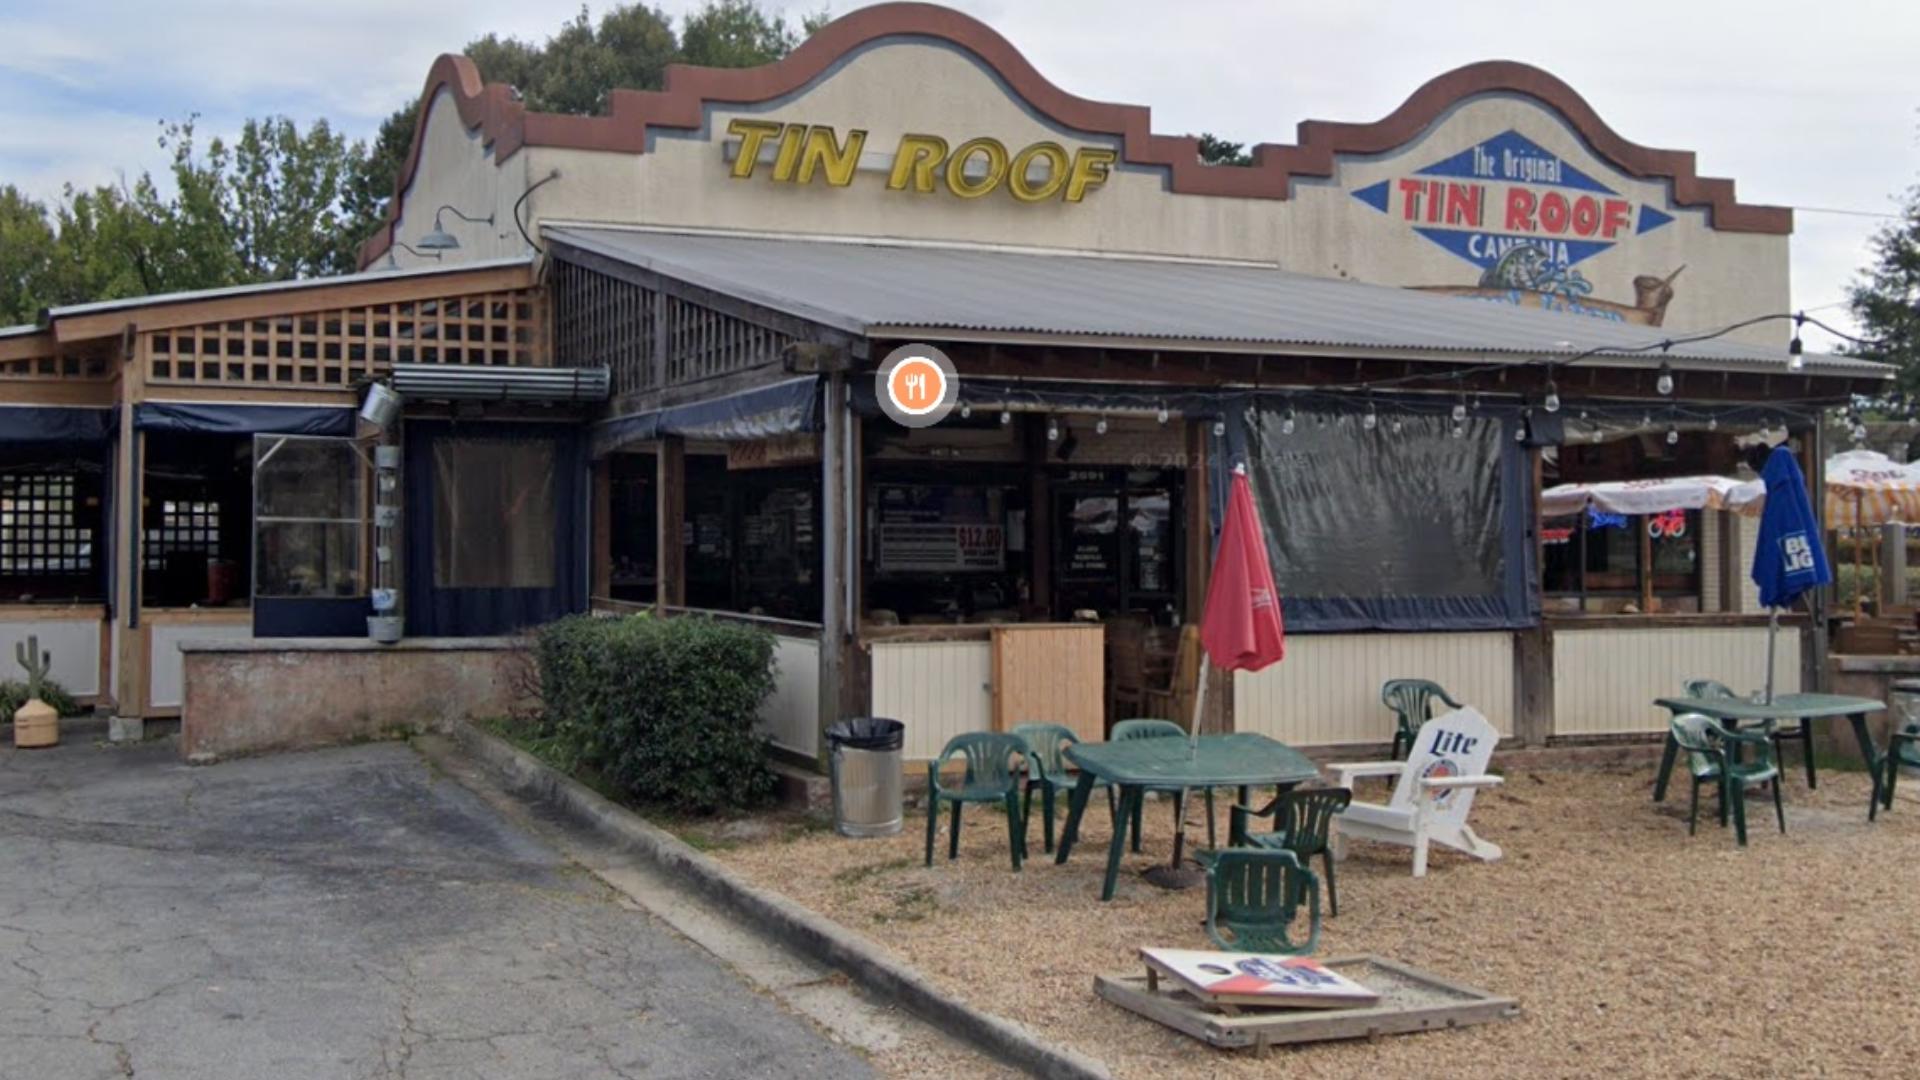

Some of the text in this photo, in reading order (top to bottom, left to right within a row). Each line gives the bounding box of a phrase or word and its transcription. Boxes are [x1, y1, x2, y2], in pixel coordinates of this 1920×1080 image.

[727, 118, 1118, 203] TIN ROOF
[1474, 146, 1562, 184] The Original
[1399, 178, 1633, 239] TIN ROOF
[1468, 234, 1570, 266] CANNA
[959, 527, 1001, 549] $12.00
[1429, 729, 1478, 757] Lite
